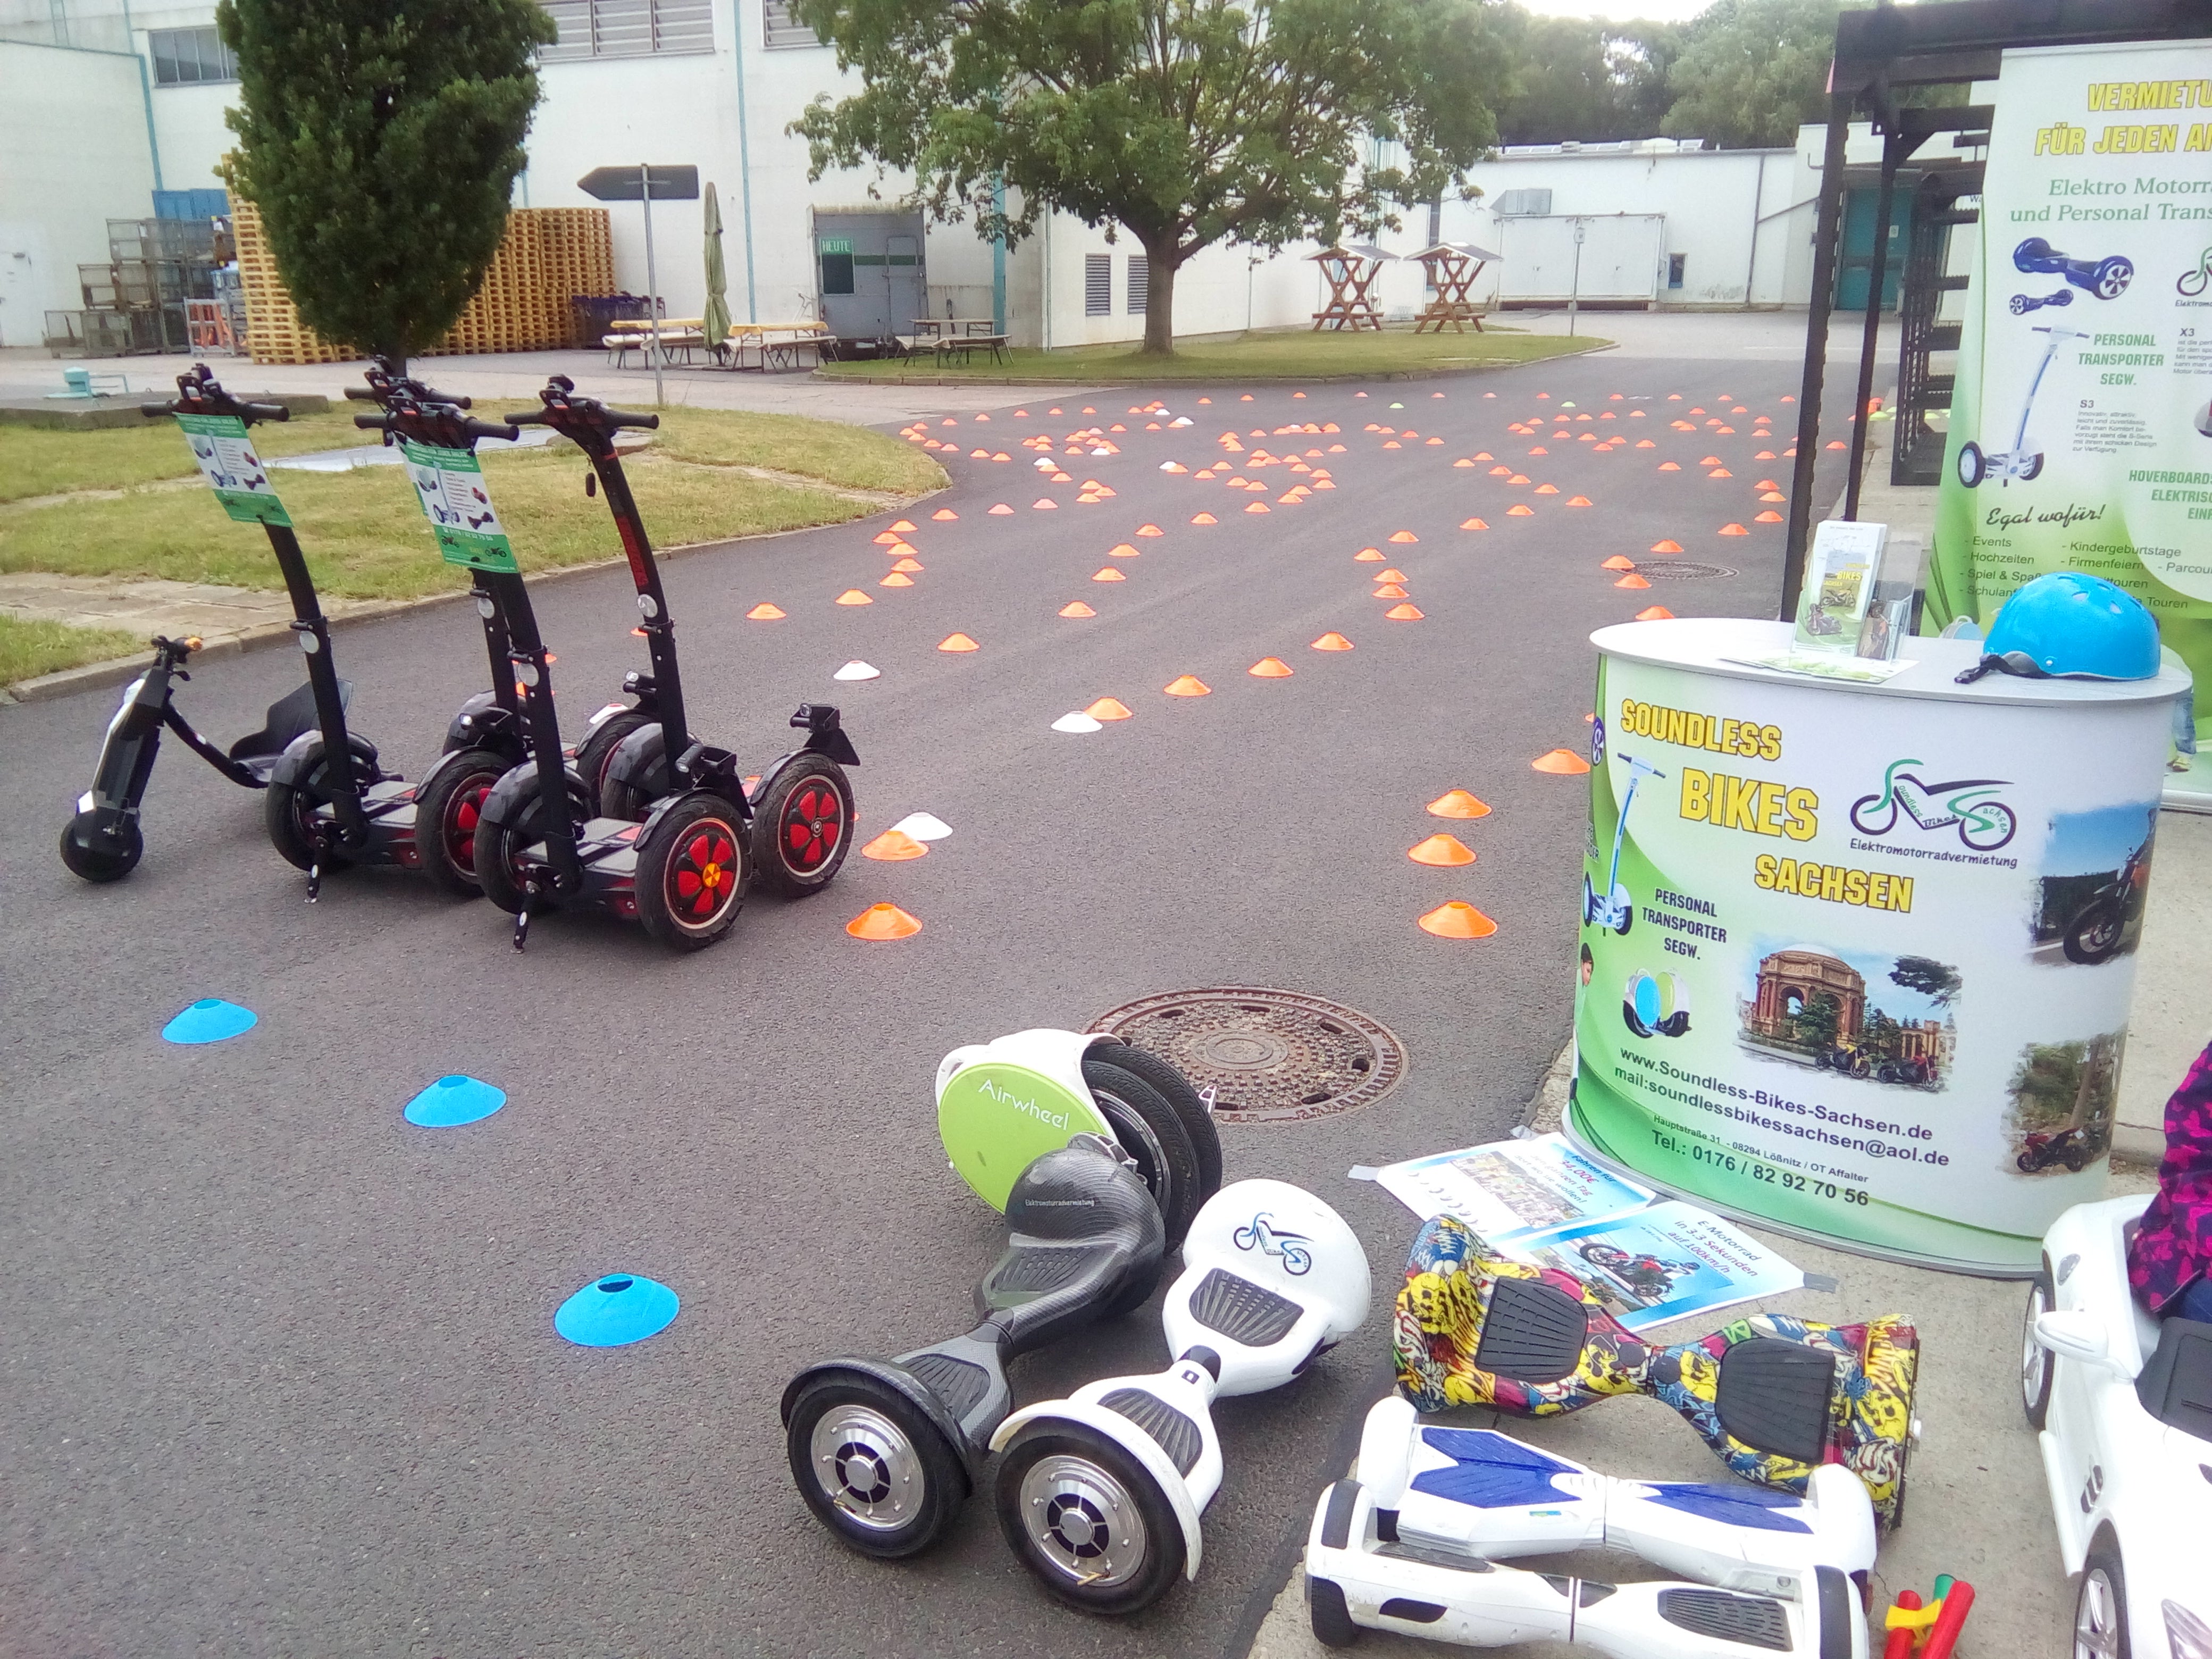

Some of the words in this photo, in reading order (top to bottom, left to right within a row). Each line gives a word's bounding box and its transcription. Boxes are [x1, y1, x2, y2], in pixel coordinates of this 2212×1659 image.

[2034, 122, 2087, 155] FÜR
[2093, 124, 2179, 154] JEDEN
[2049, 179, 2127, 196] Elektro
[2133, 177, 2212, 195] Motorr
[2010, 205, 2051, 222] und
[2057, 203, 2150, 221] Personal
[822, 240, 851, 252] HEUTE
[2093, 334, 2156, 346] PERSONAL
[2180, 328, 2195, 337] X3
[2078, 353, 2165, 366] TRANSPORTER
[2100, 373, 2137, 386] SEGW.
[2080, 400, 2094, 408] S3
[2128, 470, 2212, 485] HOVERBOARD
[1986, 506, 2034, 531] Egal
[2037, 503, 2107, 528] wofür!
[1973, 536, 2012, 547] Events
[2069, 541, 2181, 558] Kindergeburtstage
[1970, 551, 2034, 565] Hochzeiten
[2068, 556, 2144, 570] Firmenfeiern
[1836, 570, 1862, 581] BIKES
[1967, 568, 1996, 580] Spiel
[1999, 572, 2008, 580] &
[2146, 596, 2188, 609] Touren
[1620, 698, 1782, 761] SOUNDLESS
[1679, 766, 1819, 842] BIKES
[1850, 837, 2018, 869] Elektromotorradvermietung
[1754, 853, 1914, 914] SACHSEN
[1654, 887, 1718, 918] PERSONAL
[1641, 906, 1727, 943] TRANSPORTER
[1663, 937, 1701, 960] SEGW.
[977, 1078, 1070, 1131] Airwheel
[1620, 1047, 1933, 1141] www.Soundless-Bikes-Sachsen.de
[1614, 1066, 1950, 1166] mail:soundlessbikessachsen@aol.de
[1652, 1129, 1687, 1156] Tel.:
[1692, 1145, 1737, 1171] 0176
[1753, 1165, 1776, 1184] 82
[1782, 1172, 1807, 1193] 92
[1813, 1179, 1837, 1199] 70
[1844, 1187, 1870, 1206] 56
[1710, 1134, 1721, 1145] 31
[1732, 1141, 1761, 1157] 08294
[1763, 1150, 1802, 1168] Lößnitz
[1810, 1163, 1826, 1174] OT
[1828, 1167, 1869, 1184] Affalter
[1697, 1220, 1762, 1261] E-Motorrad
[1668, 1231, 1690, 1243] auf
[1685, 1243, 1731, 1274] 100km/h
[1704, 1240, 1759, 1277] Sekunden
